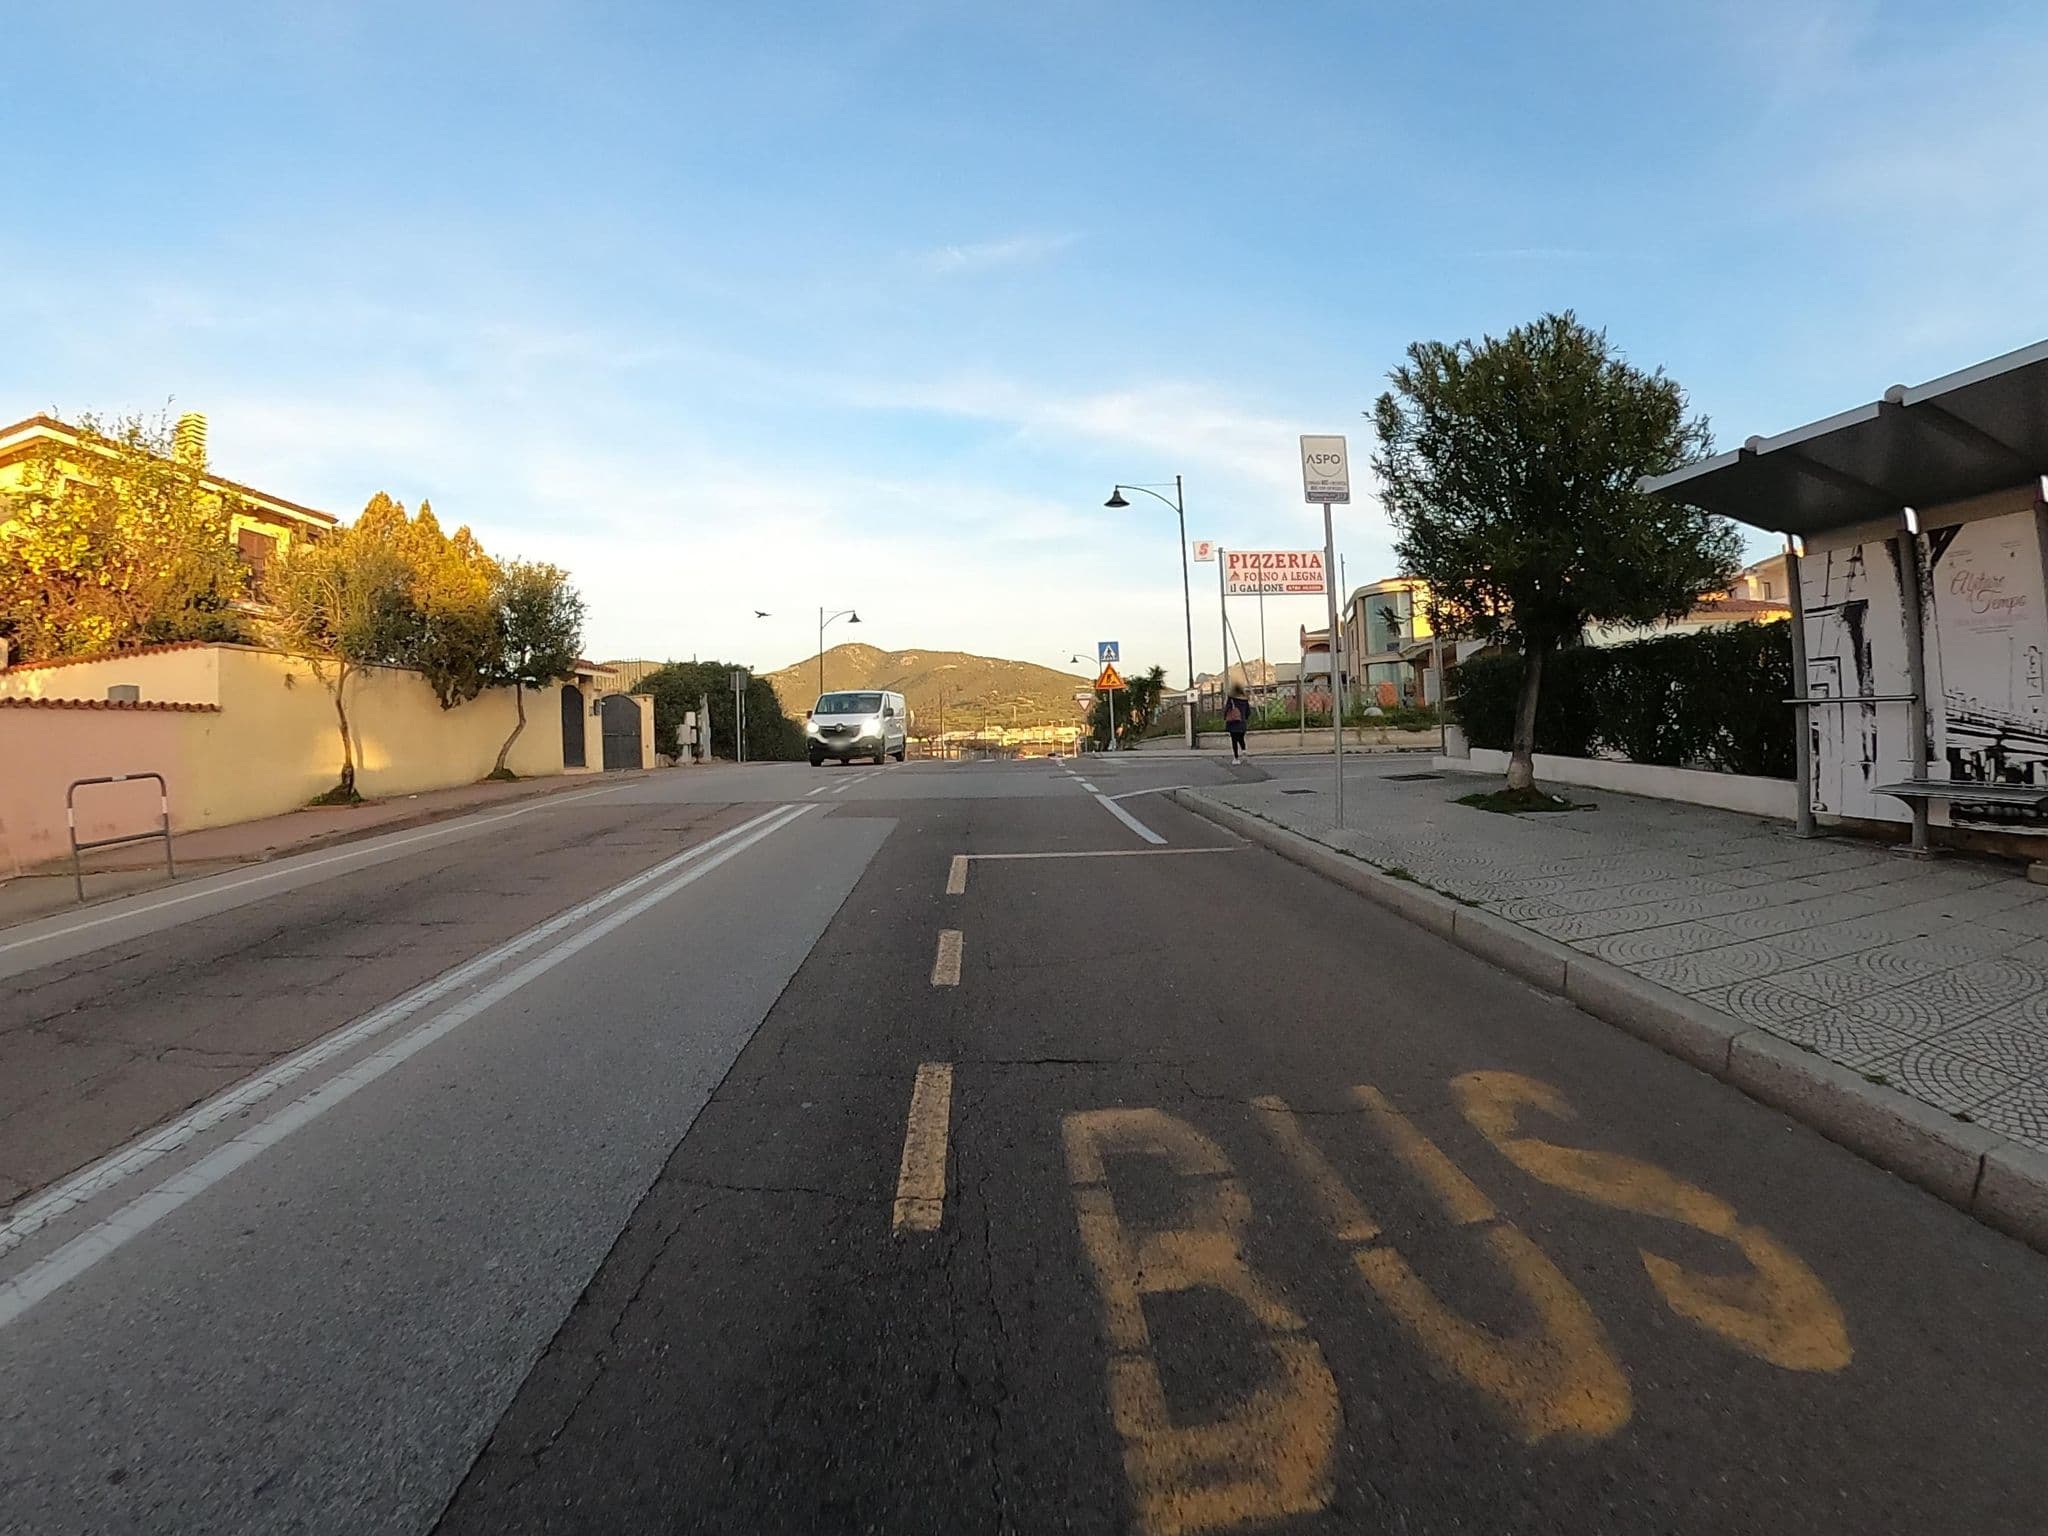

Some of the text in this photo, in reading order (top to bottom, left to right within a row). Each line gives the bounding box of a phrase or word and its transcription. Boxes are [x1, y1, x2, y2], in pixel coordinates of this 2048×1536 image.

[1306, 453, 1341, 464] ASPO
[1228, 553, 1322, 569] PIZZERIA
[1281, 572, 1288, 581] A
[1290, 571, 1323, 581] LEGNA
[1239, 583, 1284, 593] GALONE
[1061, 1068, 1855, 1534] BUS
